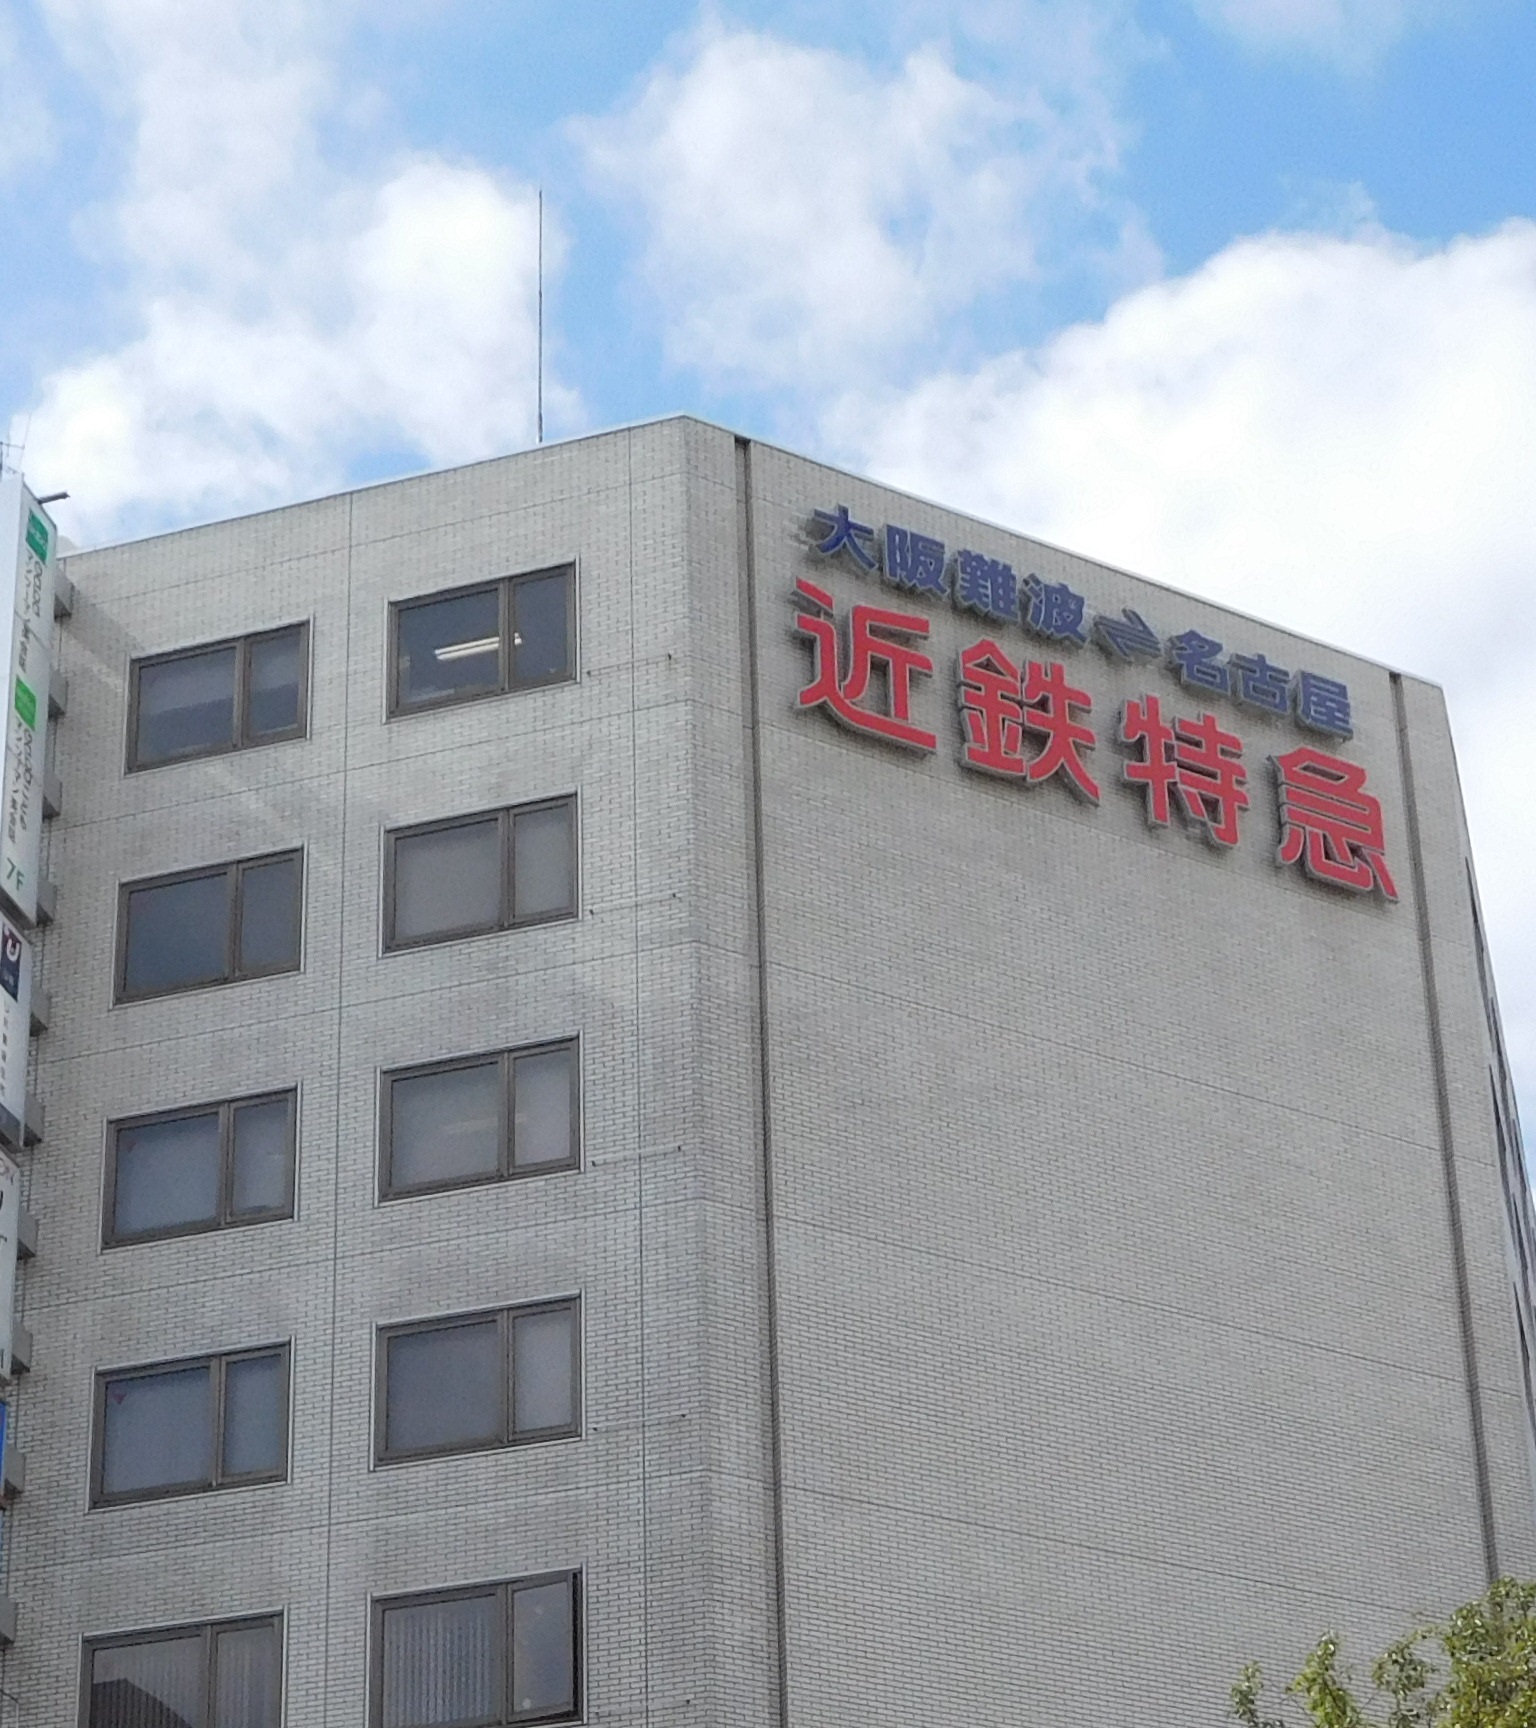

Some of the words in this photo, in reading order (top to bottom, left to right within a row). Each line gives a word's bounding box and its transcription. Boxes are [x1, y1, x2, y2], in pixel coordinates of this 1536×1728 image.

[792, 577, 1398, 903] 近鉄特急
[811, 504, 1087, 649] 大阪難波
[1169, 630, 1353, 742] 名古屋
